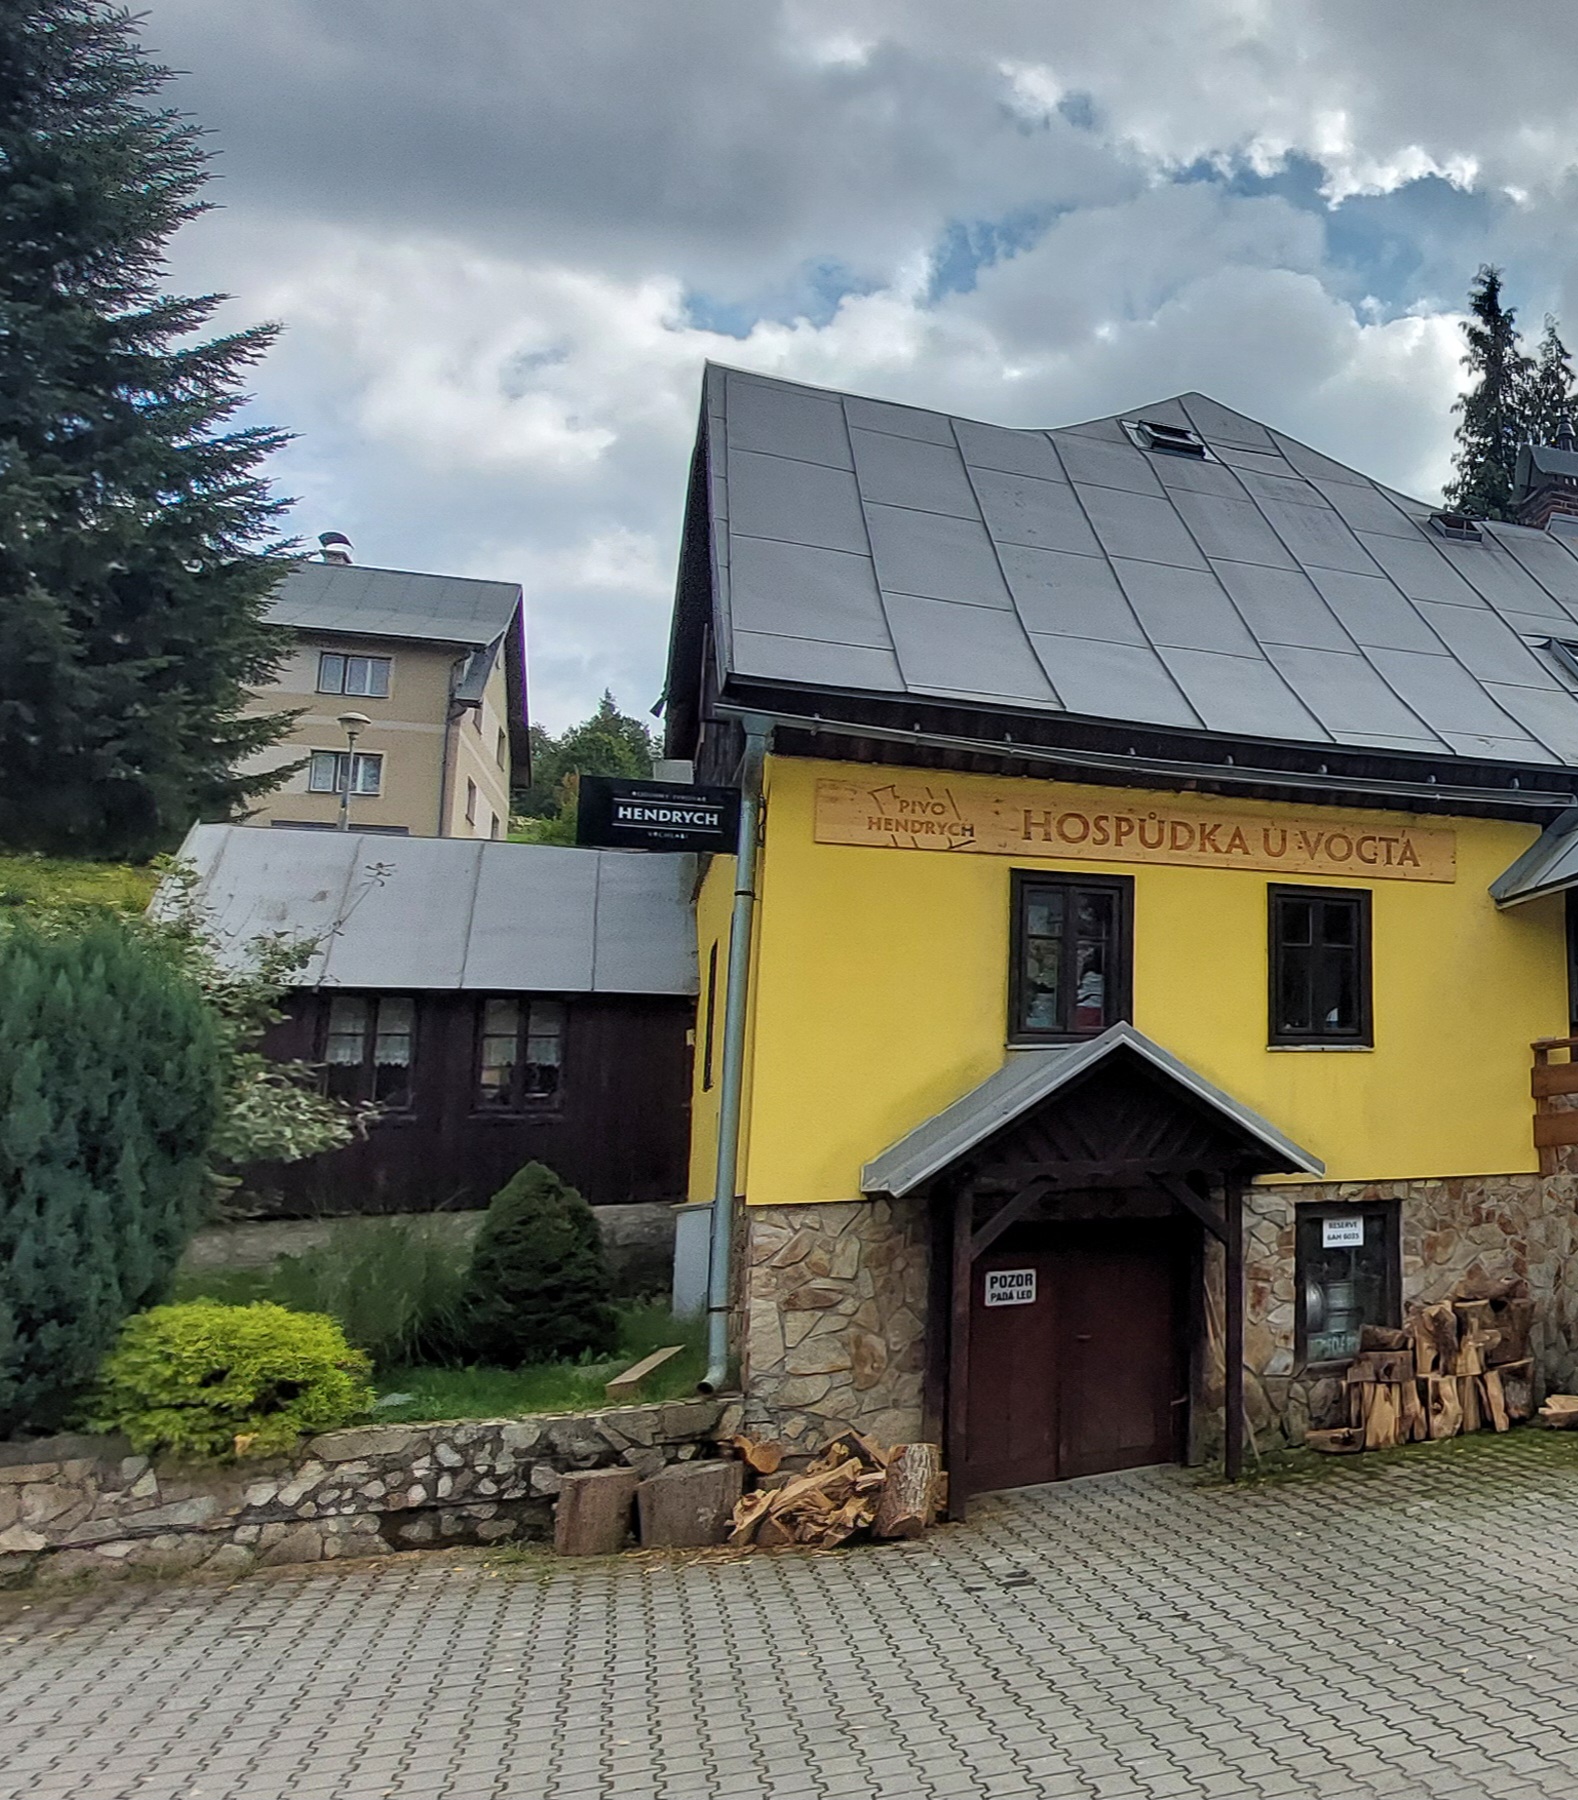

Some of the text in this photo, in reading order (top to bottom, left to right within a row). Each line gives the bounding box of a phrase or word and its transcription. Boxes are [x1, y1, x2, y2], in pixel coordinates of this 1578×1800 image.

[618, 806, 719, 825] HENDRYCH
[899, 799, 946, 816] PIVO
[867, 816, 975, 838] HENDRYCH
[1021, 809, 1252, 855] HOSPŮDKA
[1262, 827, 1288, 858] U
[990, 1273, 1033, 1289] POZOR
[1016, 1290, 1033, 1300] LED
